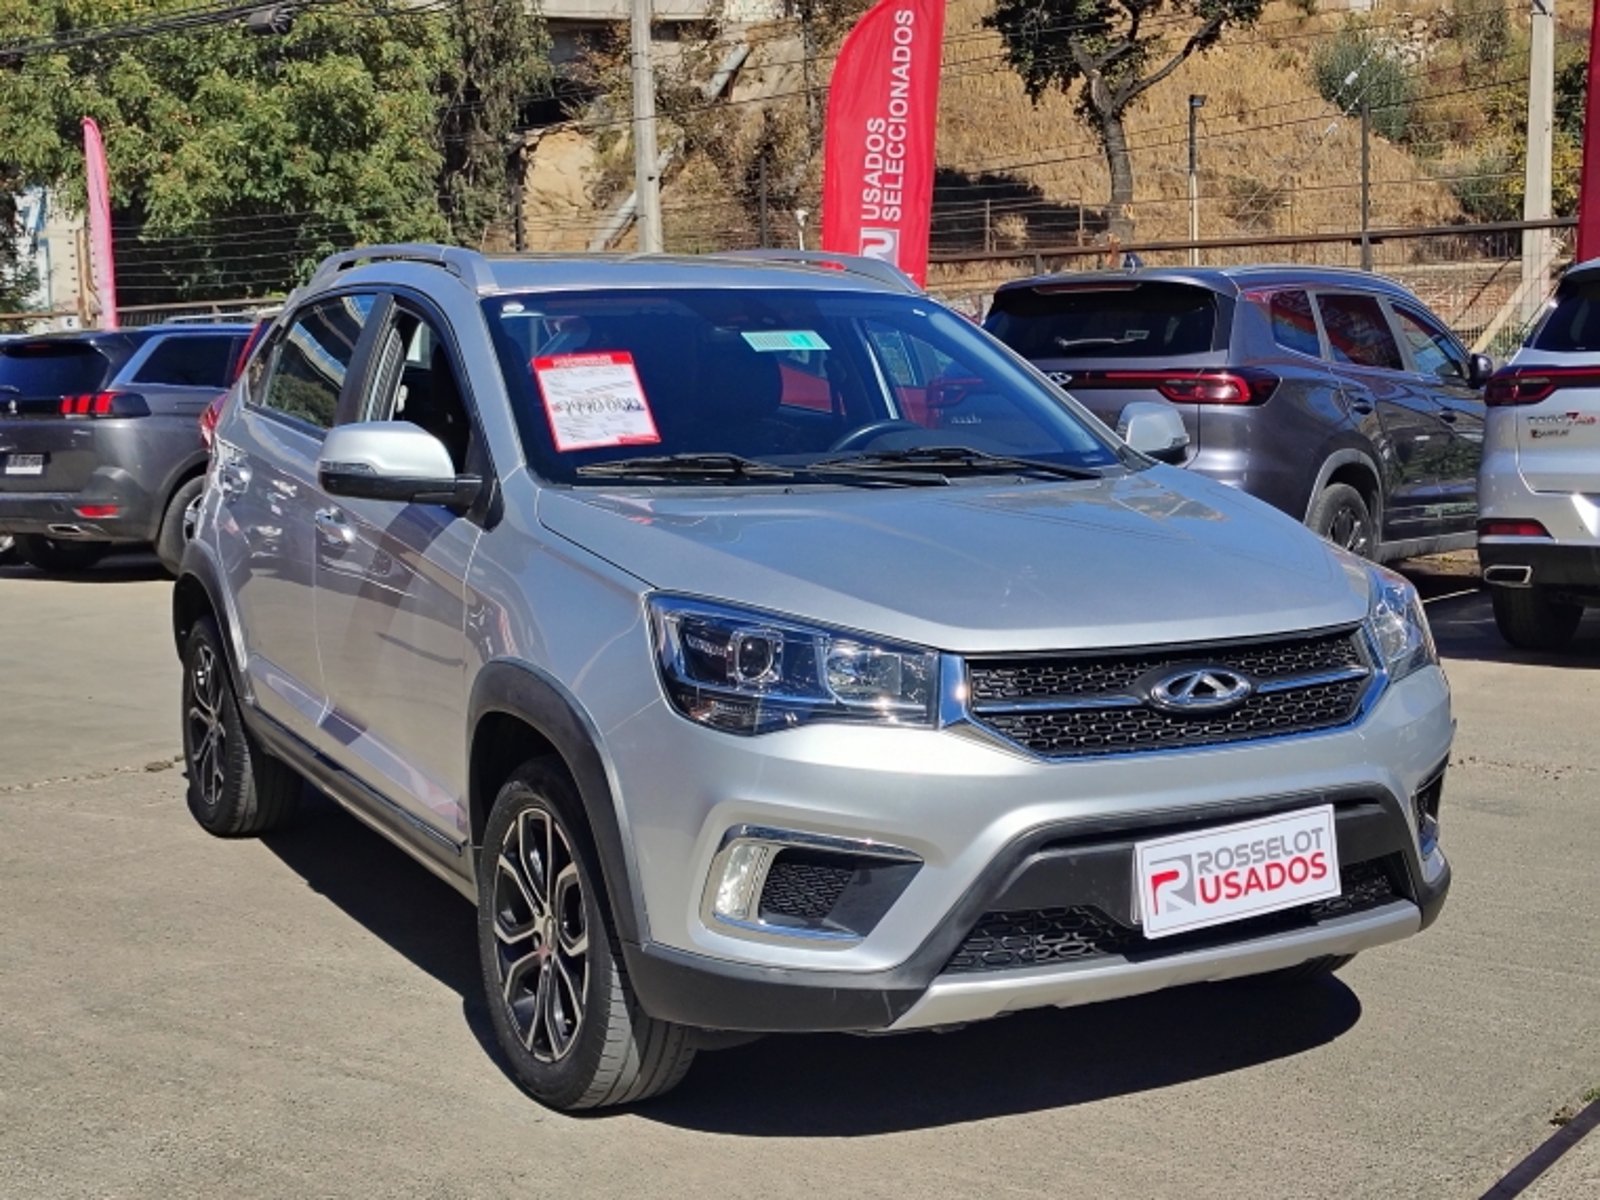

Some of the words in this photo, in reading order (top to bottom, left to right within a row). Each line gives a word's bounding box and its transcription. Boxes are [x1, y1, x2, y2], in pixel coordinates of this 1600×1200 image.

[881, 9, 914, 222] SELECCIONADOS
[860, 117, 886, 220] USADOS
[1197, 827, 1323, 874] ROSSELOT
[1199, 852, 1328, 904] USADOS
